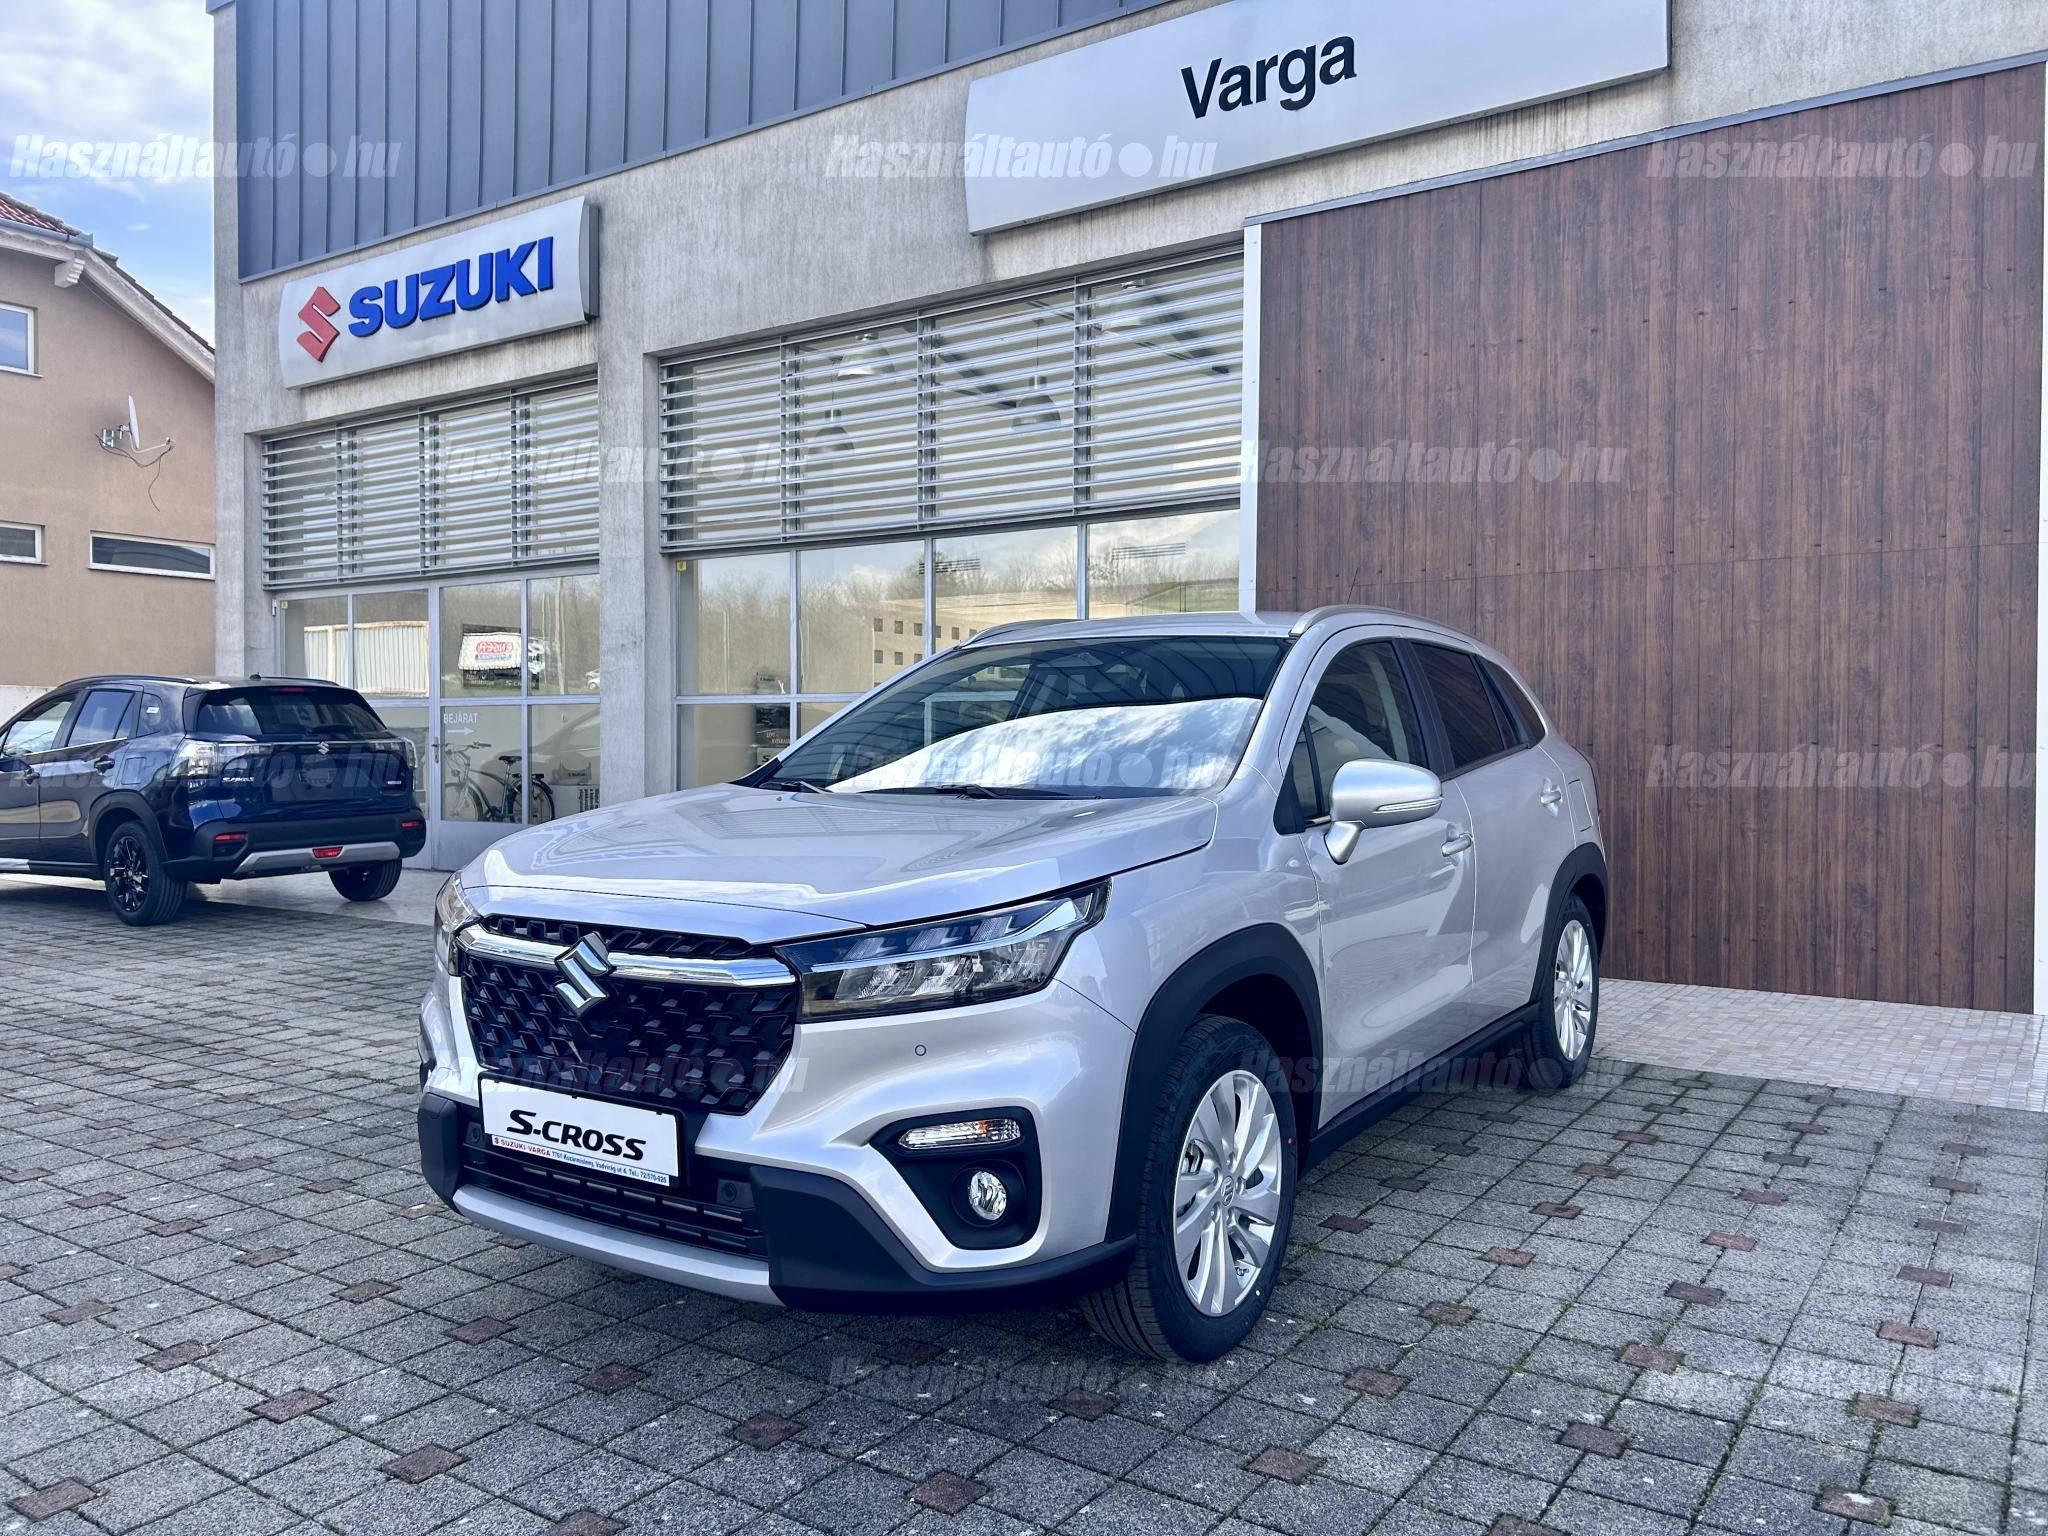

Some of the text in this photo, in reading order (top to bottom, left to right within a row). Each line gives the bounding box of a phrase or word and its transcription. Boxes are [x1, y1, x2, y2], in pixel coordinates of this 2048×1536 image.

[1181, 35, 1357, 119] Varga
[348, 236, 554, 338] SUZUKI
[506, 1109, 646, 1161] S-CROSS
